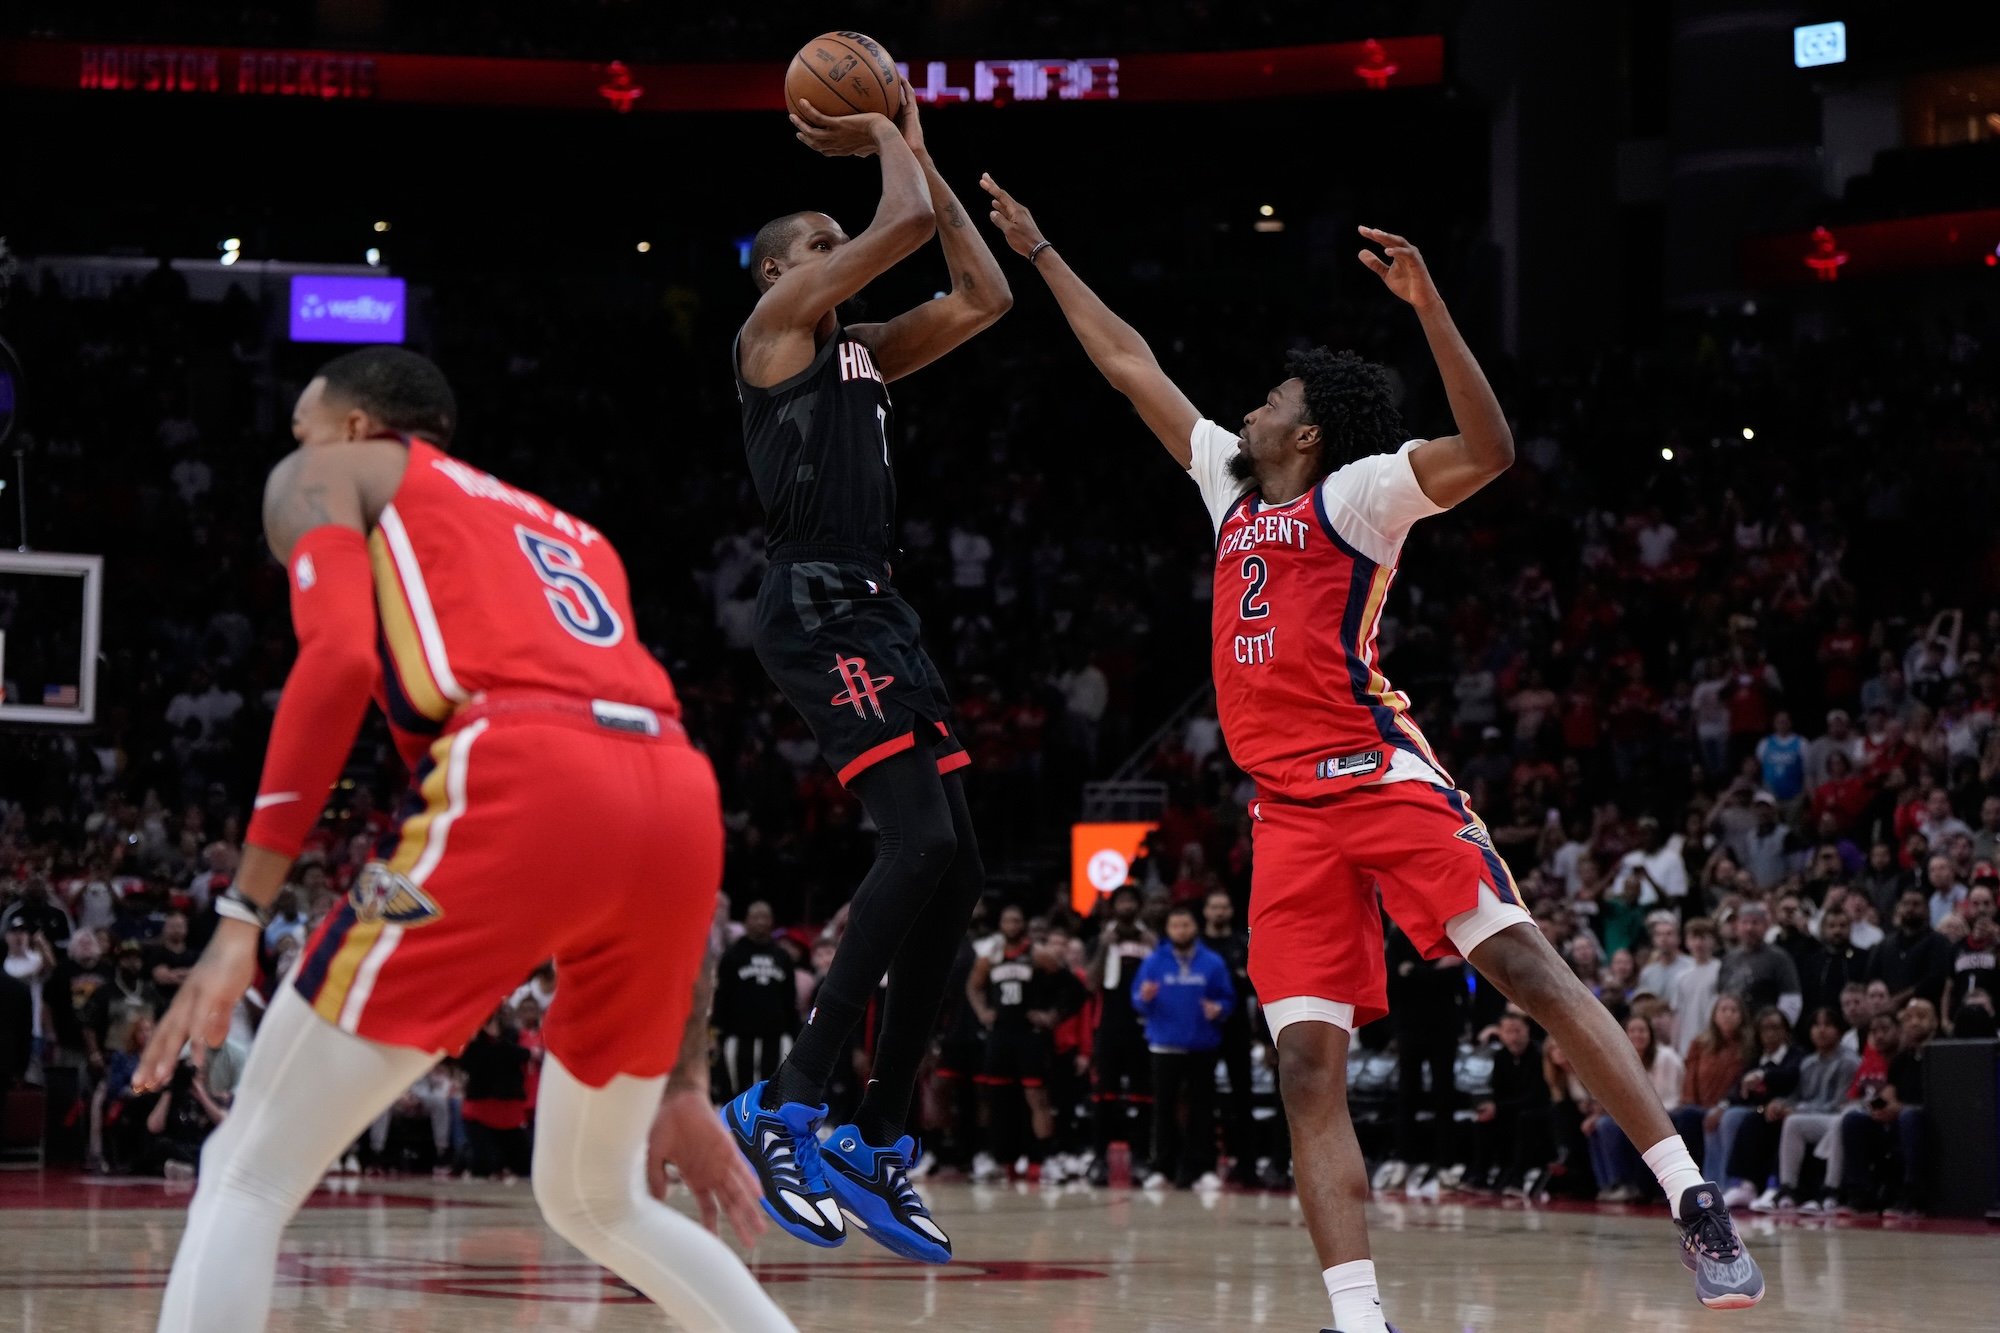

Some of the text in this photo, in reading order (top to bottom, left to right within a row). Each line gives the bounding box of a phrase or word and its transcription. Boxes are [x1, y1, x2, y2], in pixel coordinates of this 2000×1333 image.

[80, 48, 377, 99] HOUSTON ROCKETS
[876, 403, 891, 467] 7
[514, 523, 624, 647] 5
[1240, 554, 1270, 621] 2
[1234, 626, 1277, 665] CITY
